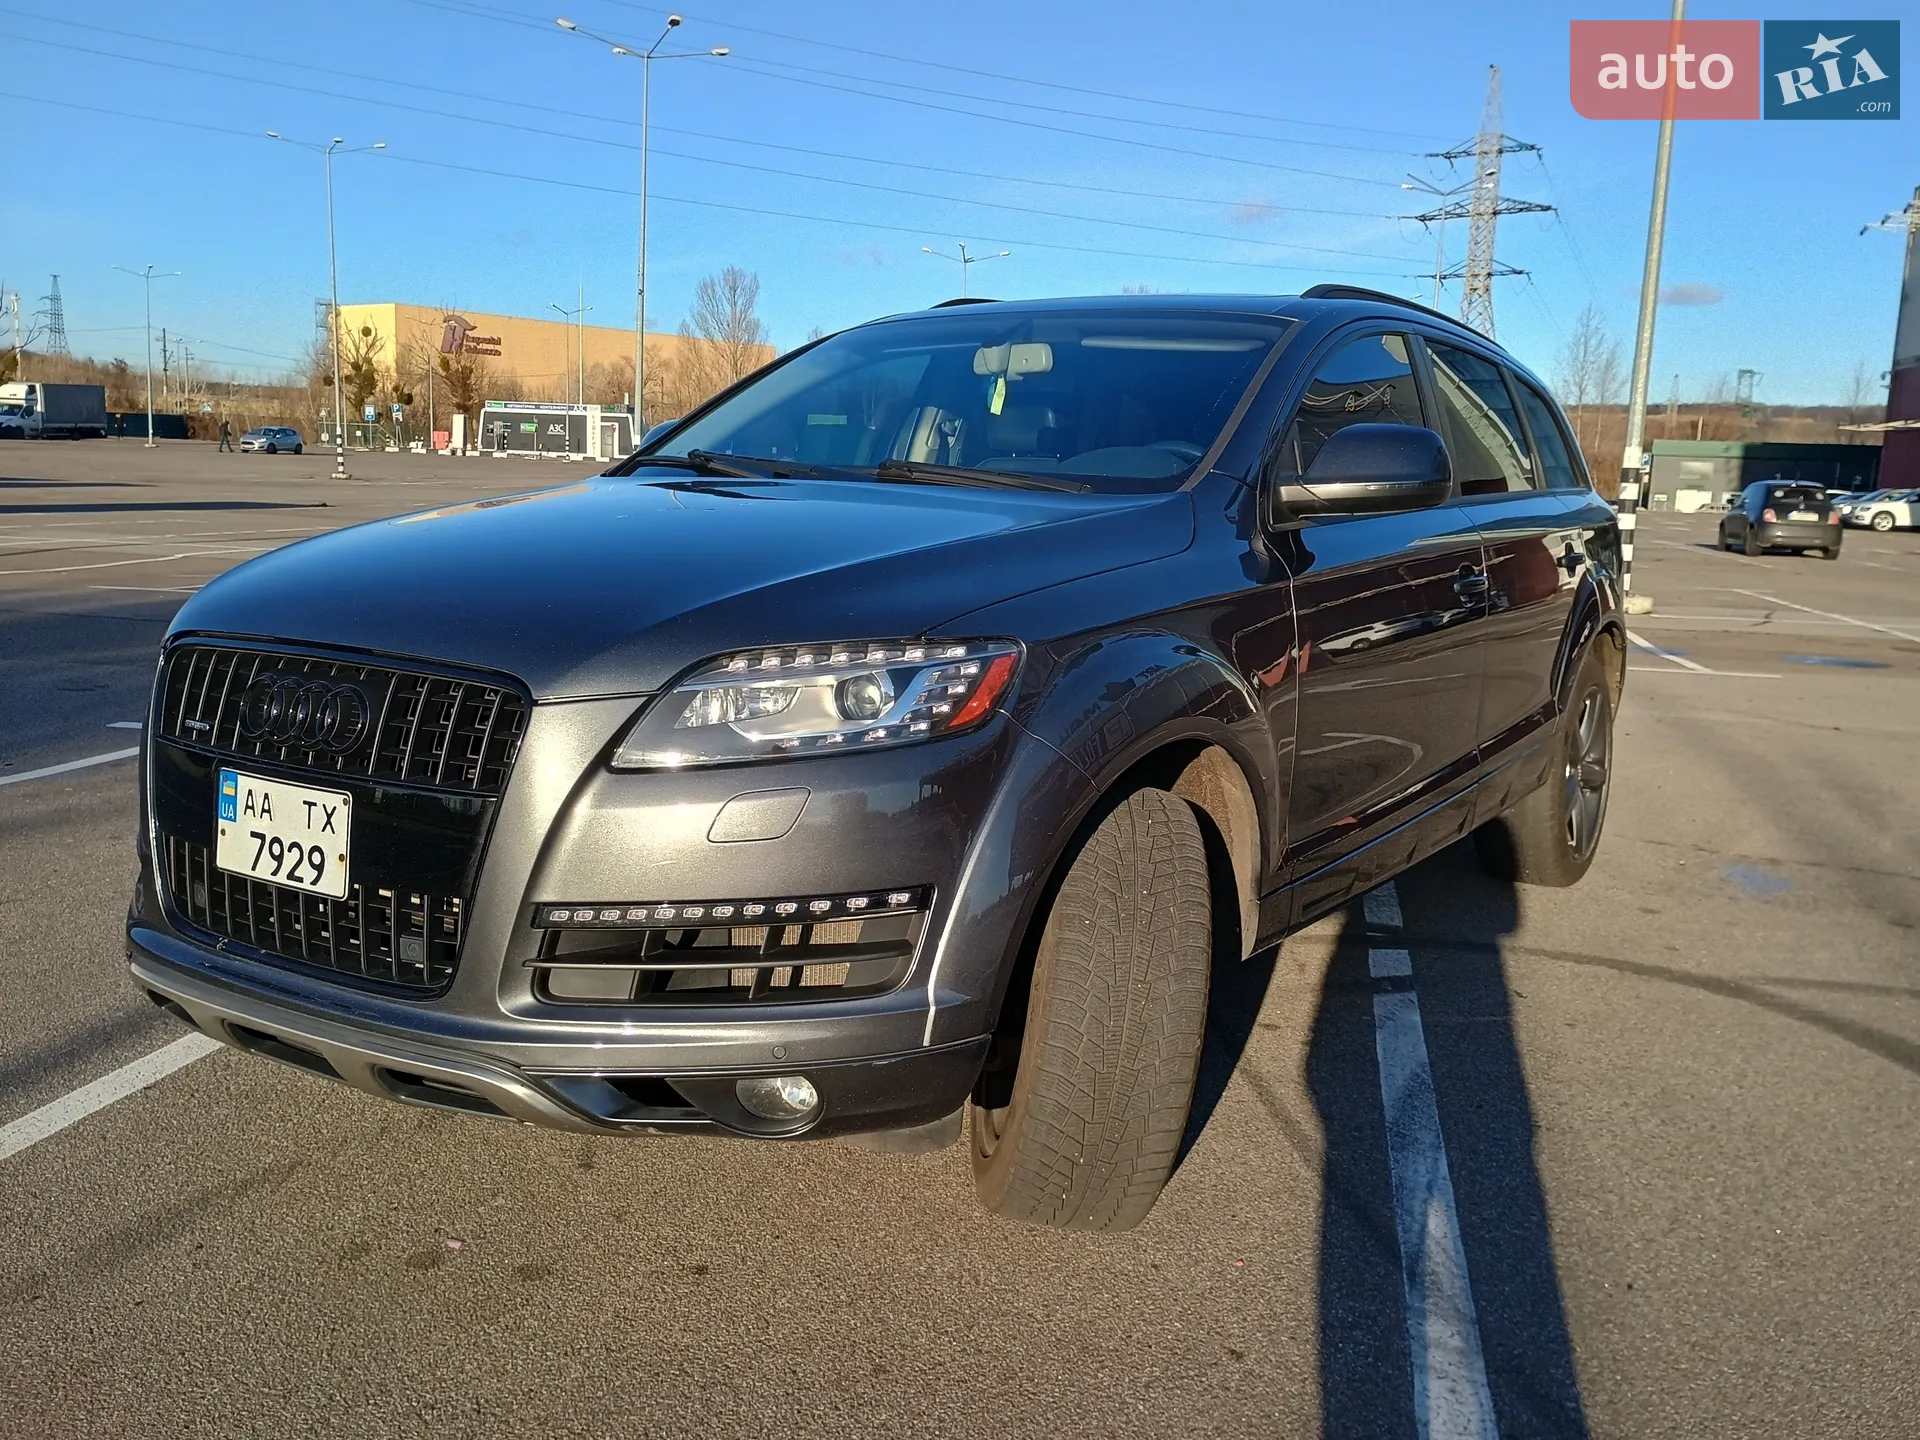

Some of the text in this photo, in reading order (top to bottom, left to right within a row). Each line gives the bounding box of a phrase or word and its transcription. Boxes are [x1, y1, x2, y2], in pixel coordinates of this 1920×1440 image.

[548, 423, 564, 433] АЗС
[221, 802, 235, 820] UA
[243, 788, 337, 835] AA TX
[249, 830, 326, 887] 7929
